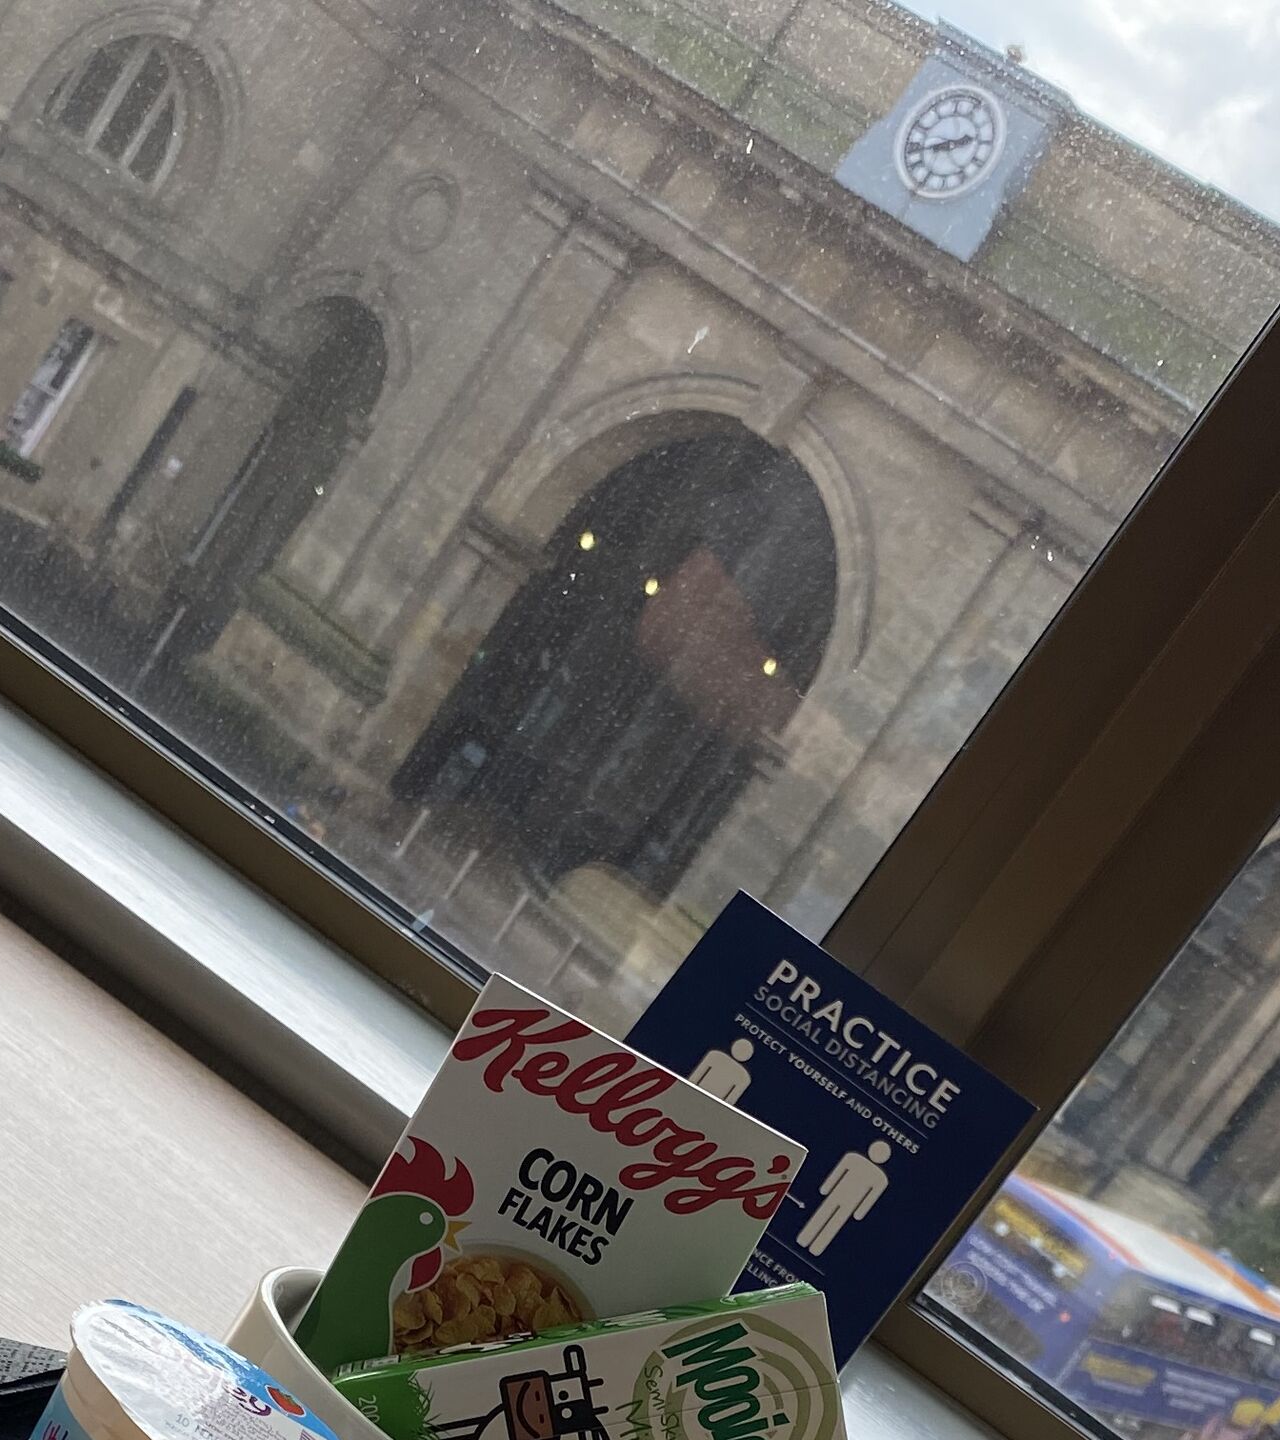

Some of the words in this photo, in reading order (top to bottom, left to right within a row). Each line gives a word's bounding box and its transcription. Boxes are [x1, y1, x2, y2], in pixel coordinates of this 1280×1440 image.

[734, 1013, 787, 1055] PROTECT
[787, 1052, 847, 1100] YOURSELF
[845, 1096, 872, 1119] AND
[872, 1116, 919, 1154] OTHERS
[754, 986, 821, 1045] SOCIAL
[825, 1038, 940, 1129] DISTANCING
[767, 959, 961, 1113] PRACTICE
[452, 1009, 791, 1219] Kellogg's
[497, 1187, 609, 1266] FLAKES
[519, 1148, 634, 1236] CORN
[773, 1264, 800, 1283] FRO
